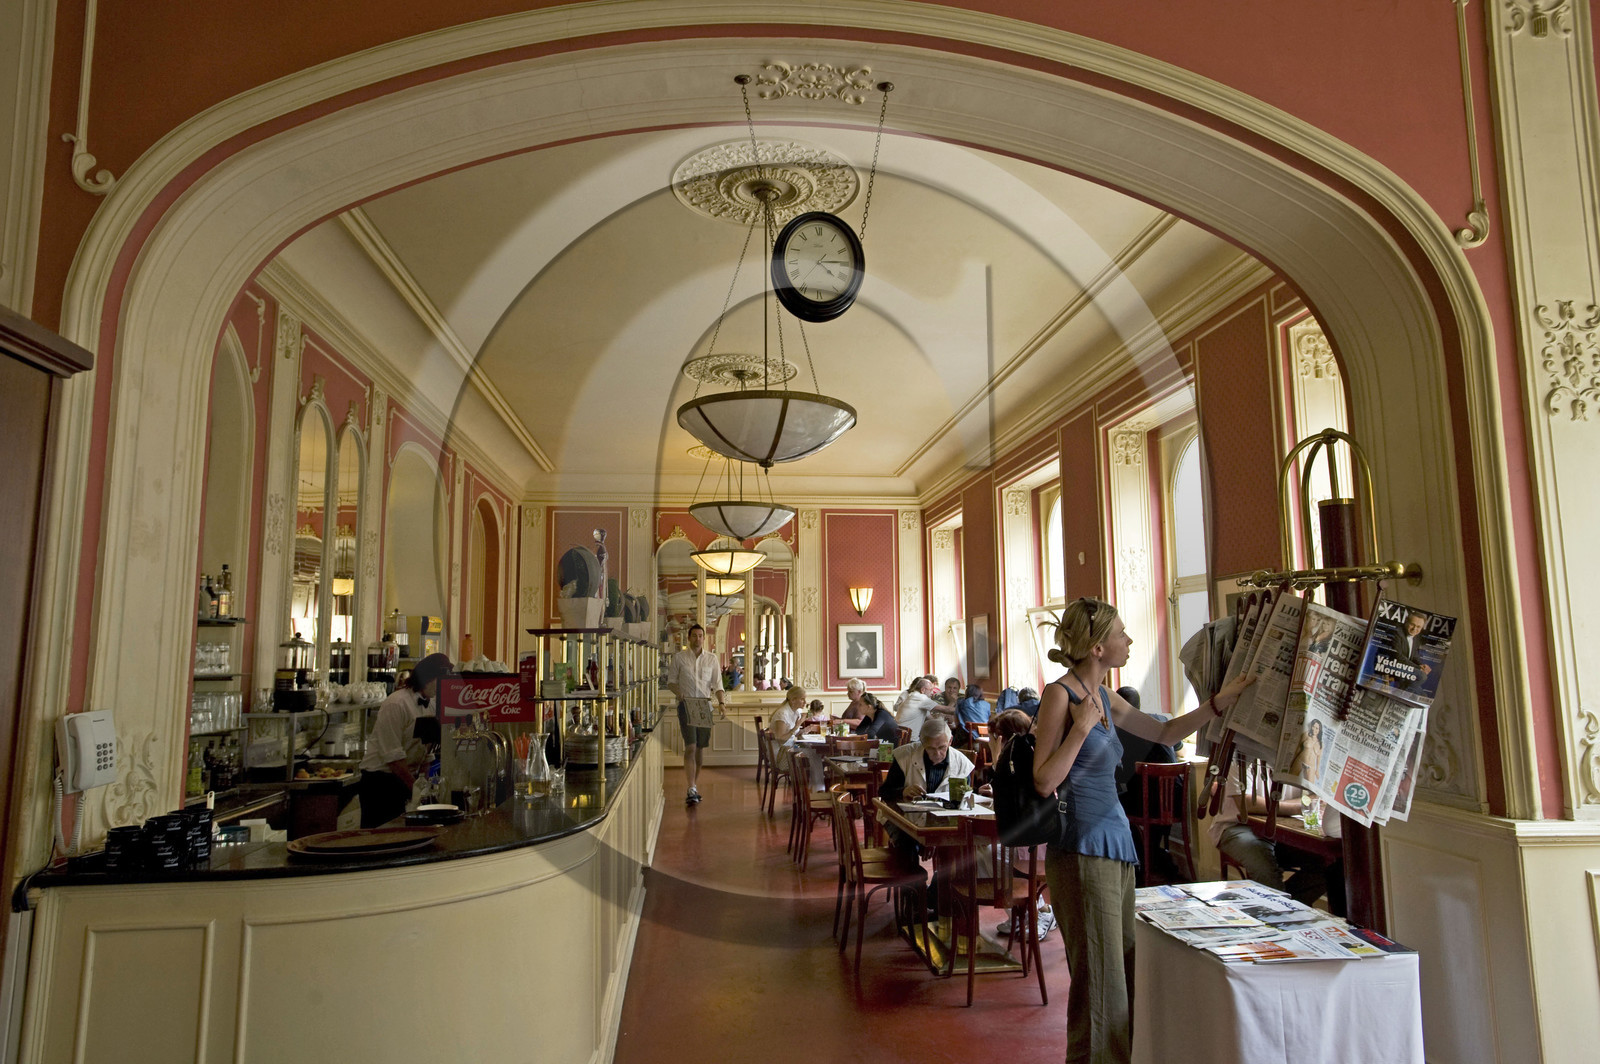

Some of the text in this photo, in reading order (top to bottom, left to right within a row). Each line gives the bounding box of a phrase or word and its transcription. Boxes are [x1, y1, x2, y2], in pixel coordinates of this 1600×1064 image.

[1280, 604, 1301, 618] LID
[1379, 602, 1450, 636] XAYPA
[1334, 628, 1362, 646] Zwilli
[1330, 639, 1360, 664] Jetz
[1324, 656, 1355, 681] rede
[1374, 663, 1417, 682] Moravce
[1376, 655, 1415, 673] Václava
[458, 682, 521, 706] Coca-Cola
[501, 704, 522, 715] Coke
[1341, 728, 1361, 742] durch
[1360, 737, 1391, 757] Rauchen
[1359, 729, 1396, 752] Krebs-Tote
[1350, 787, 1366, 799] 29
